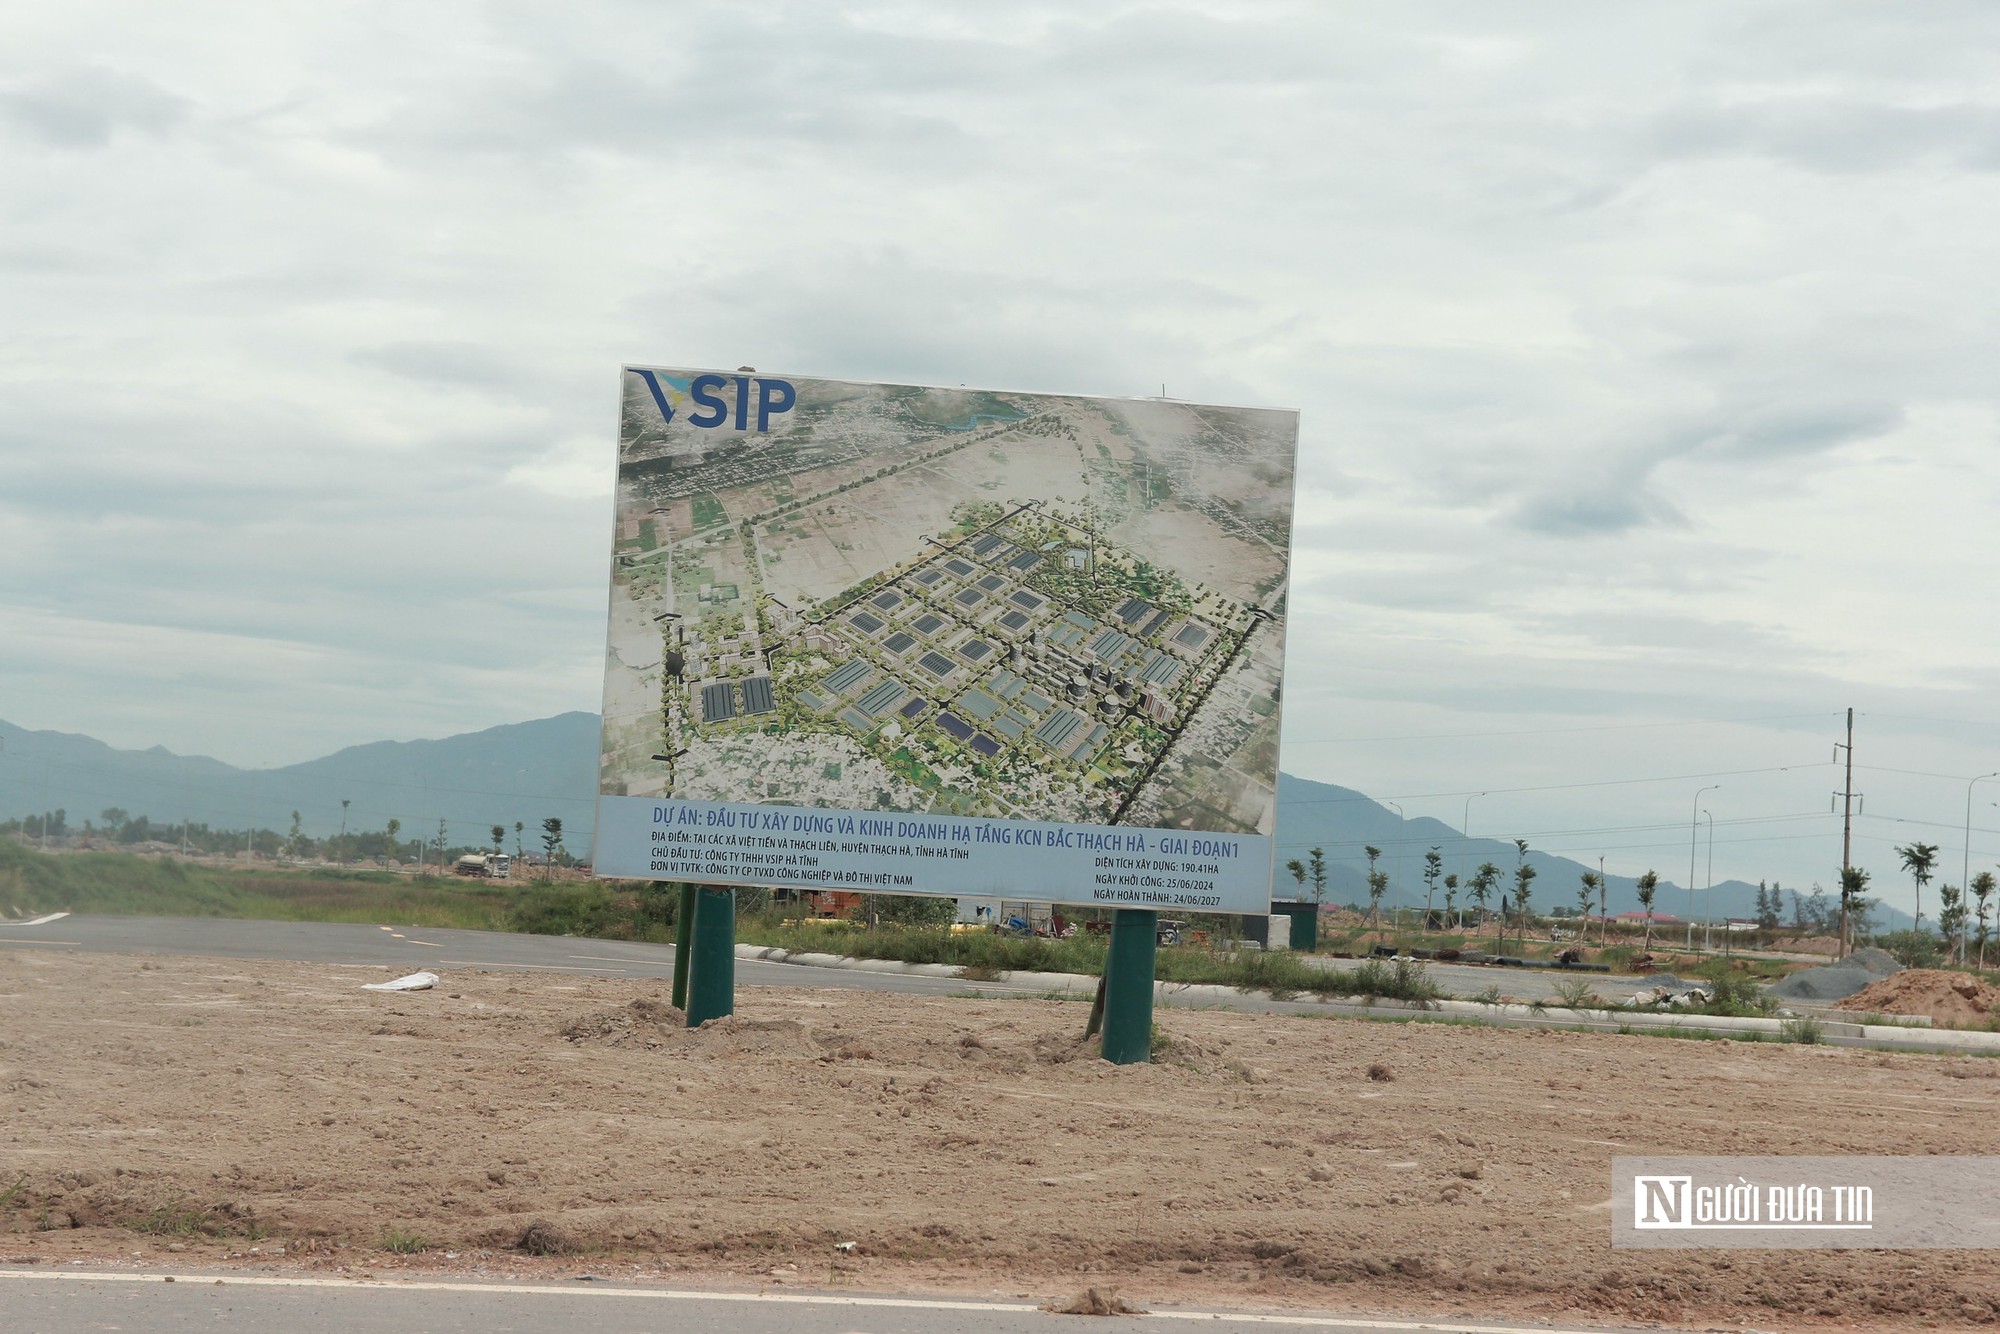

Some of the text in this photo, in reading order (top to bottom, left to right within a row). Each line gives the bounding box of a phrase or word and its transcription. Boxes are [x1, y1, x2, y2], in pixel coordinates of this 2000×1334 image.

[627, 368, 796, 432] VSIP
[653, 806, 674, 827] DỰ
[678, 806, 702, 826] ÁN:
[706, 806, 736, 827] ĐẦU
[740, 811, 759, 829] TƯ
[762, 812, 789, 830] XÂY
[793, 815, 834, 836] DỰNG
[838, 816, 854, 834] VÀ
[860, 820, 894, 836] KINH
[898, 822, 947, 840] DOANH
[952, 825, 970, 845] HẠ
[975, 823, 1010, 844] TẦNG
[1016, 829, 1042, 846] KCN
[1047, 828, 1073, 848] BẮC
[1076, 832, 1121, 853] THẠCH
[1126, 833, 1145, 852] HÀ
[1160, 838, 1188, 855] GIAI
[1192, 840, 1238, 860] ĐOẠN1
[652, 831, 666, 843] ĐỊA
[694, 834, 706, 845] TẠI
[708, 834, 724, 845] CÁC
[726, 835, 736, 846] XÃ
[738, 836, 756, 848] VIỆT
[778, 837, 788, 848] VÀ
[790, 840, 816, 852] THẠCH
[819, 840, 839, 853] LIÊN,
[842, 842, 868, 854] HUYỆN
[871, 844, 897, 856] THẠCH
[900, 844, 913, 857] HÀ,
[937, 847, 948, 858] HÀ
[652, 846, 668, 857] CHỦ
[690, 849, 703, 859] TƯ:
[705, 850, 727, 861] CÔNG
[730, 852, 740, 862] TY
[766, 854, 783, 864] VSIP
[786, 854, 796, 865] HÀ
[651, 861, 668, 871] ĐƠN
[670, 862, 679, 874] VỊ
[681, 863, 703, 873] TVTK:
[706, 863, 727, 875] CÔNG
[730, 865, 740, 875] TY
[742, 866, 752, 876] CP
[777, 868, 799, 879] CÔNG
[801, 870, 831, 882] NGHIỆP
[834, 870, 843, 881] VÀ
[846, 871, 857, 882] ĐÔ
[860, 873, 873, 885] THỊ
[874, 873, 891, 886] VIỆT
[894, 875, 913, 885] NAM
[1095, 857, 1219, 874] DIỆN TÍCH XÂY DỰNG: 190.41HA
[1096, 874, 1116, 884] NGÀY
[1140, 876, 1164, 887] CÔNG:
[1167, 878, 1213, 890] 25/06/2024
[1094, 888, 1220, 906] NGÀY HOÀN THÀNH: 24/06/2027
